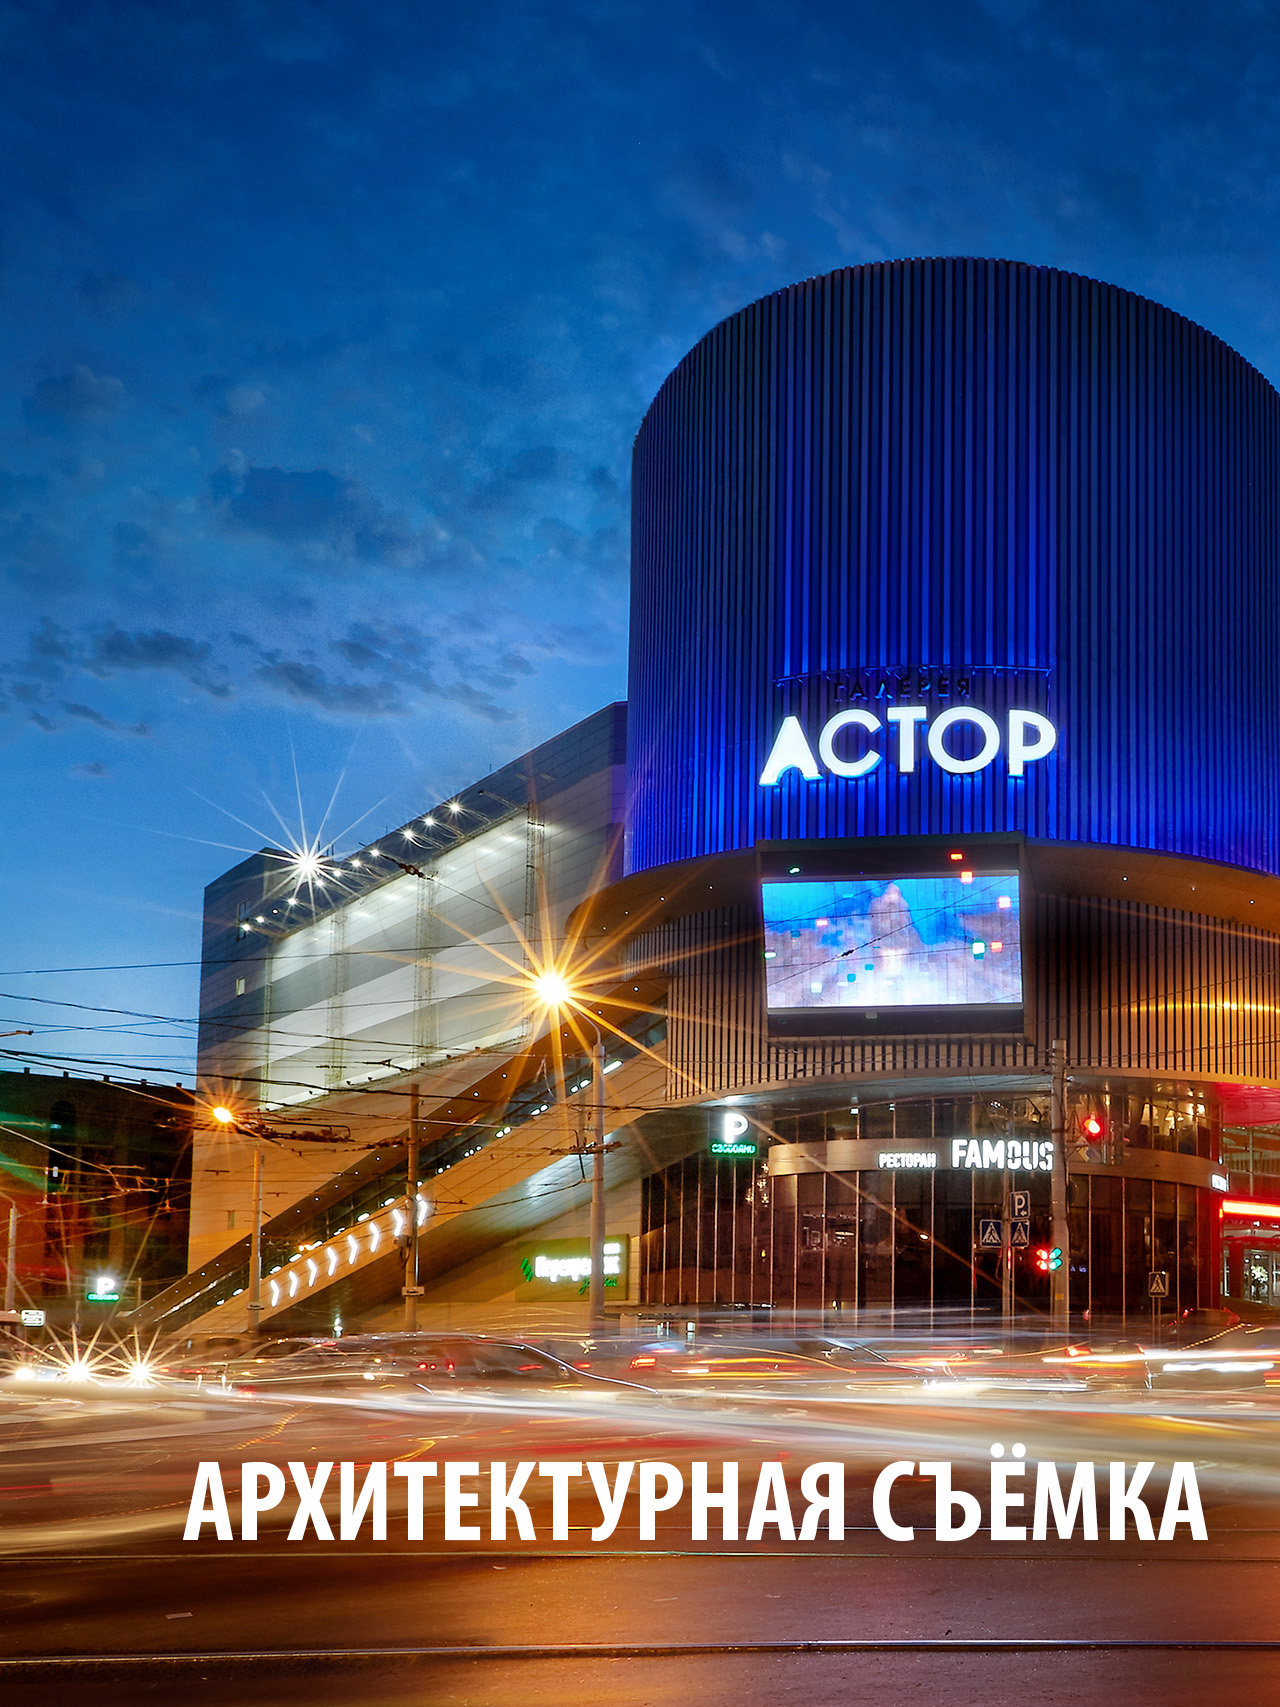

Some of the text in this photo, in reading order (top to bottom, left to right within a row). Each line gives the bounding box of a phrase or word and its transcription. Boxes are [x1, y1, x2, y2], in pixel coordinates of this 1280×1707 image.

[834, 678, 970, 702] ГАЛЕРЕЯ
[758, 705, 1057, 787] АСТОР
[878, 1138, 1055, 1171] РЕСТОРАН FAMOUS
[1014, 1194, 1026, 1217] P
